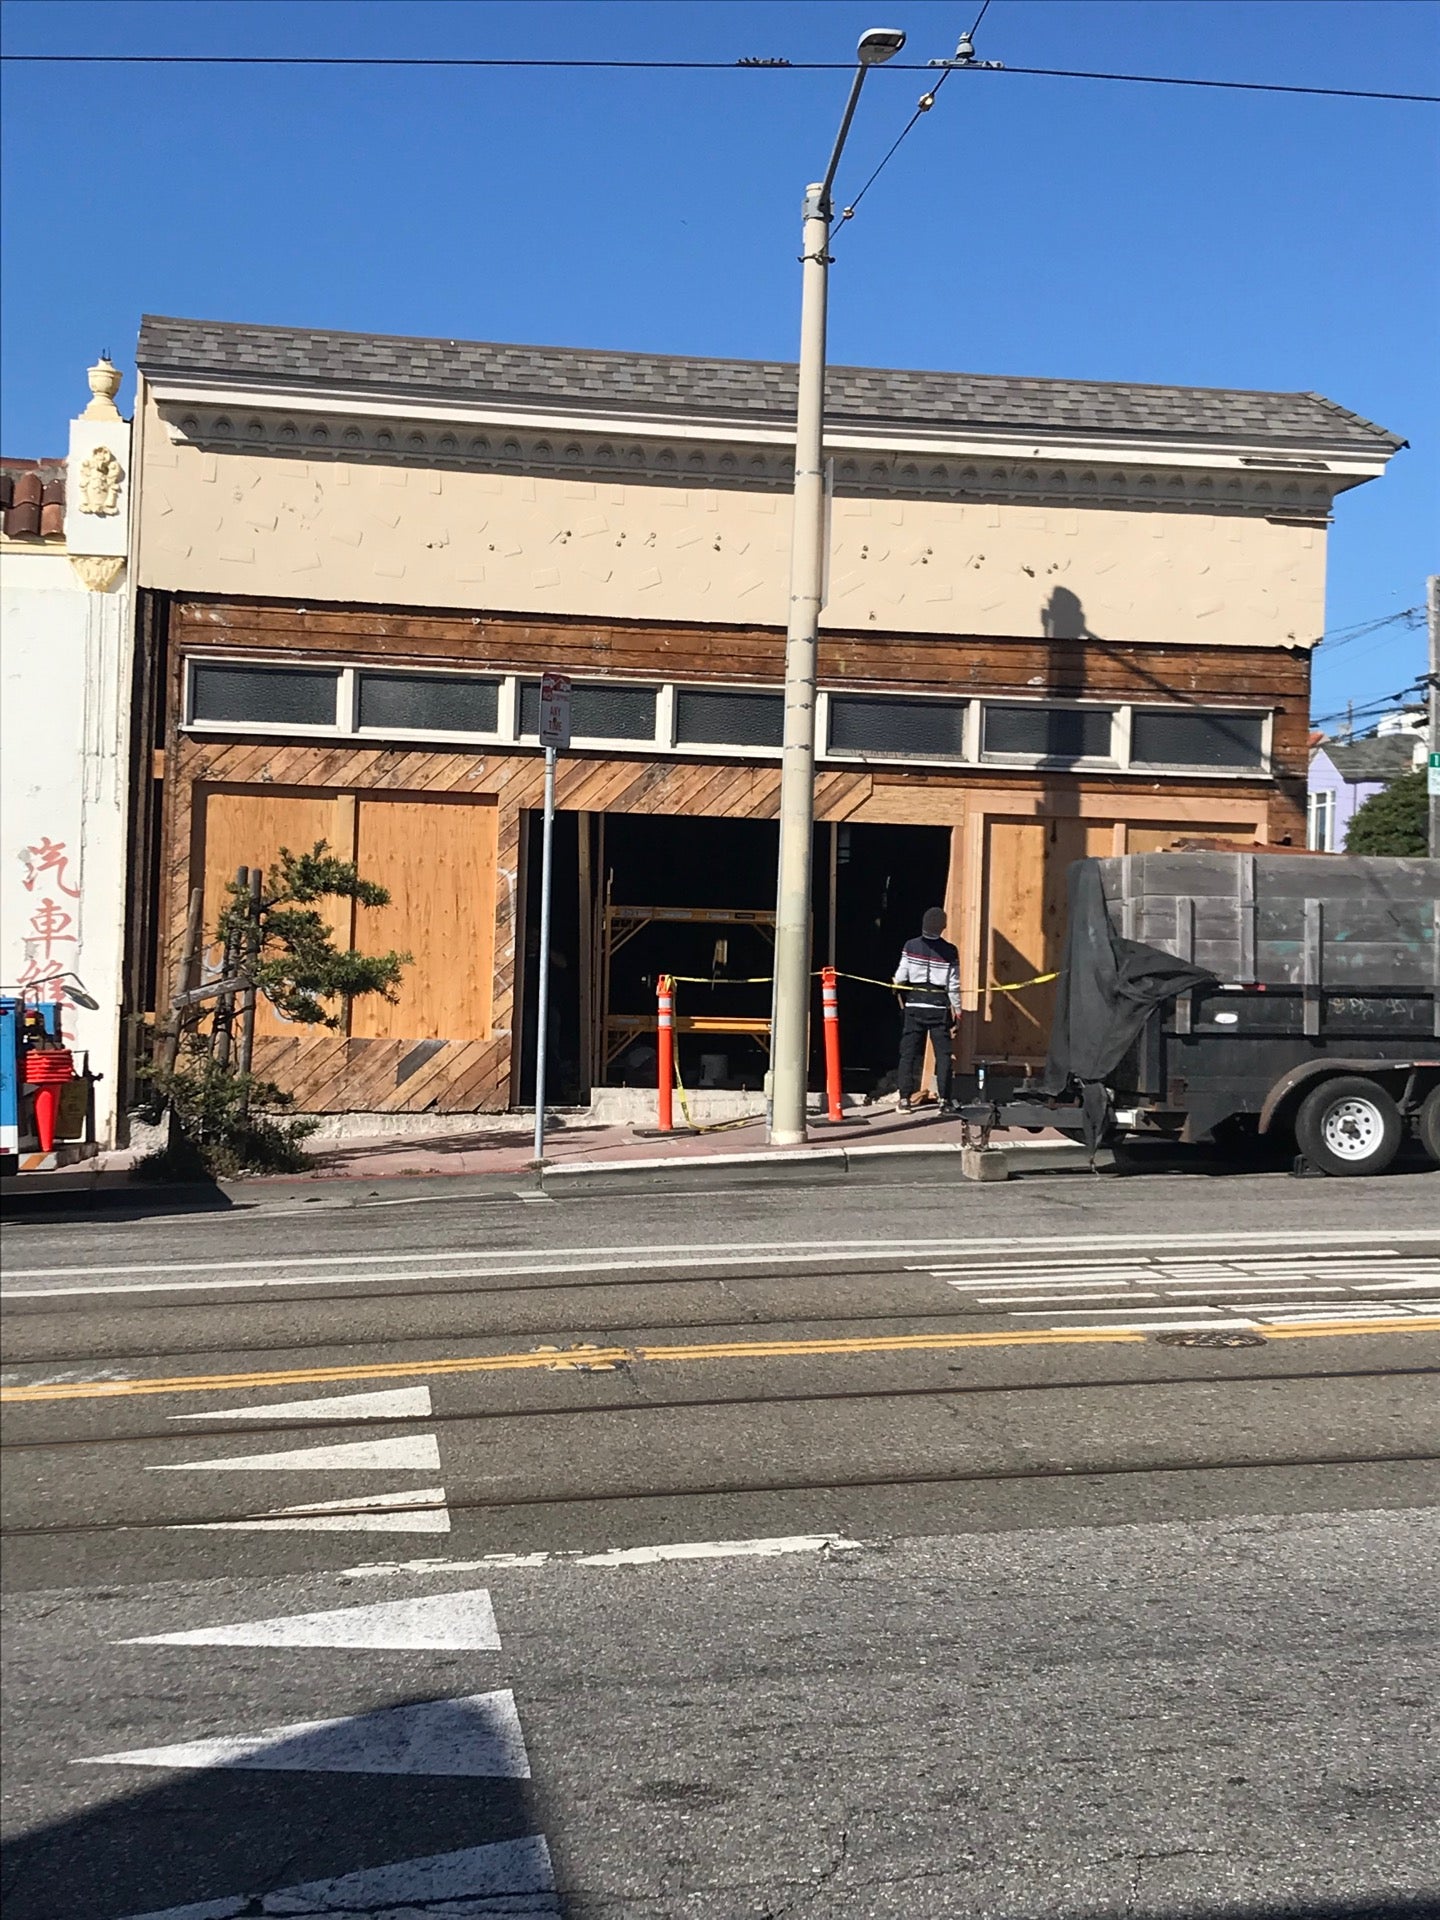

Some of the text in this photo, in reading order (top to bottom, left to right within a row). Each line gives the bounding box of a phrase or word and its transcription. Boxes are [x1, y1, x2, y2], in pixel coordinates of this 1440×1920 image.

[550, 706, 562, 717] ANY
[549, 720, 562, 732] TIME
[17, 837, 81, 1041] 汽車維
